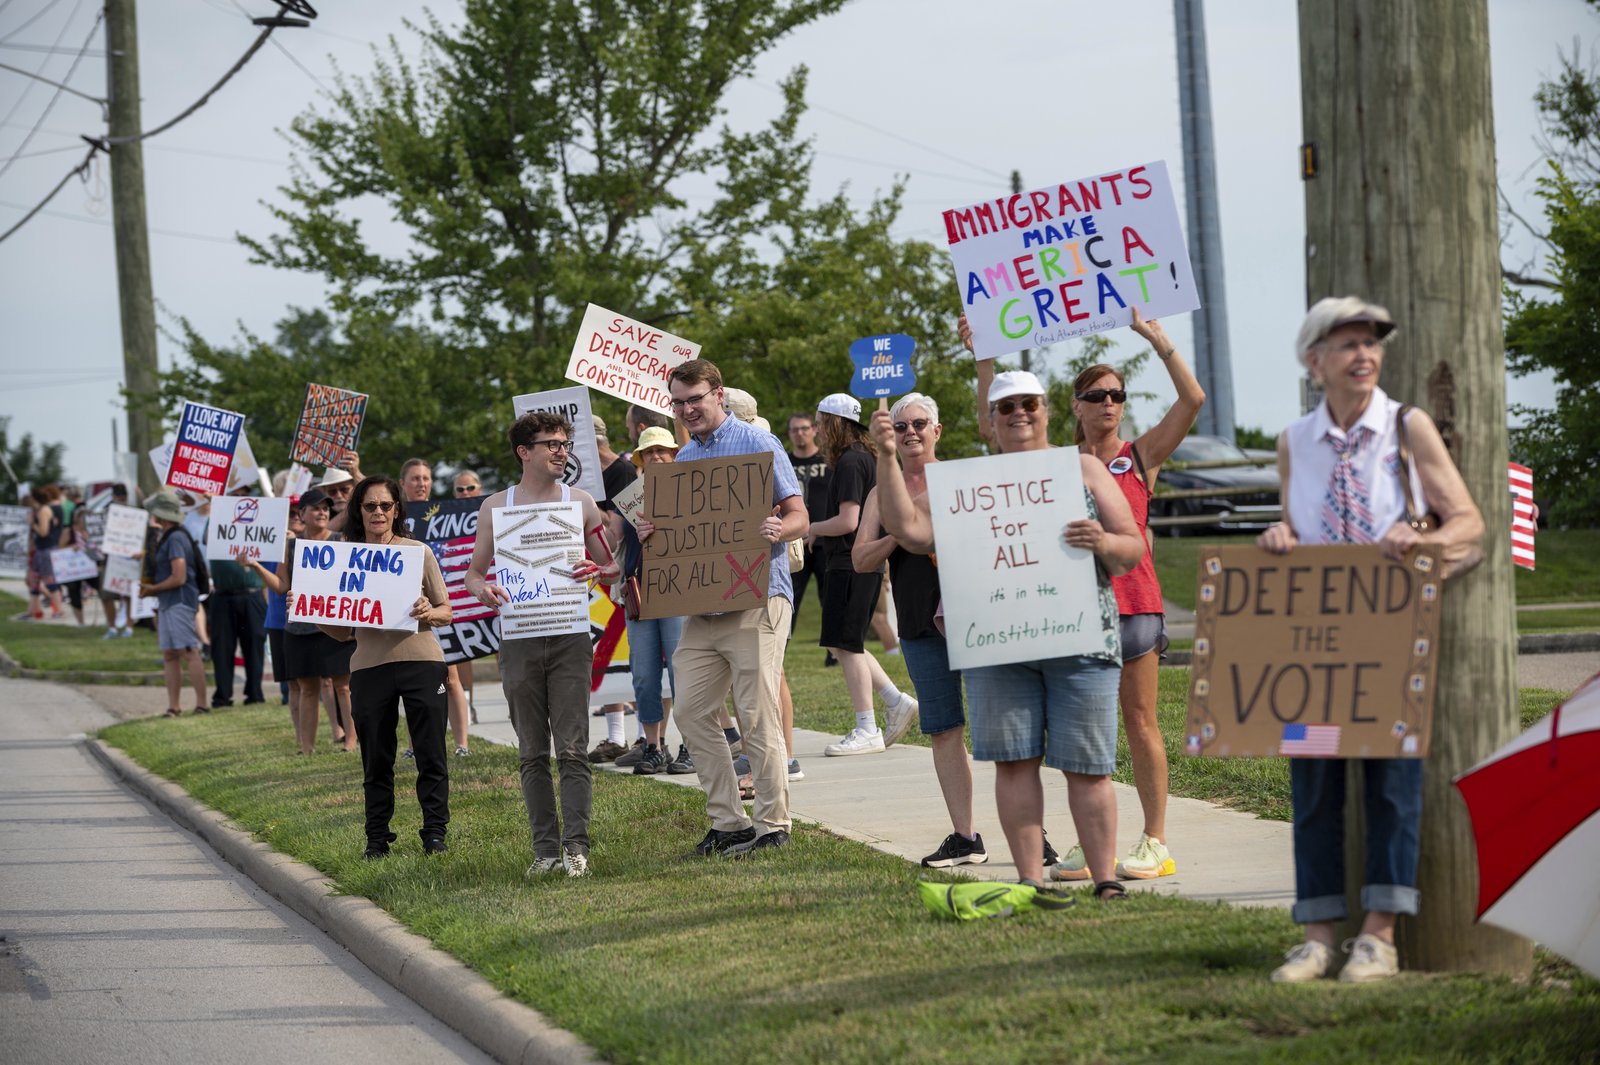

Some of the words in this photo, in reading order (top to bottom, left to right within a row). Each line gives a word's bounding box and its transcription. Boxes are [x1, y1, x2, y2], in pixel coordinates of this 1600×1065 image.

[942, 166, 1152, 245] IMMIGRANTS
[1023, 215, 1099, 248] MAKE
[967, 226, 1154, 305] AMERICA
[608, 319, 663, 350] SAVE
[672, 345, 692, 359] OUR
[874, 338, 891, 351] WE
[589, 332, 676, 381] DEMOCRAC
[872, 352, 893, 365] the
[606, 363, 622, 373] AND
[627, 369, 641, 380] THE
[862, 364, 904, 380] PEOPLE
[187, 405, 194, 422] I
[194, 407, 220, 428] LOVE
[220, 413, 238, 432] MY
[314, 396, 365, 416] WITHOUT
[185, 424, 232, 449] COUNTRY
[316, 414, 361, 436] PROCESS
[178, 445, 191, 460] I'M
[191, 449, 228, 468] ASHAMED
[171, 471, 223, 495] GOVERNMENT
[188, 462, 198, 474] OF
[198, 464, 213, 478] MY
[652, 462, 772, 519] LIBERTY
[950, 479, 1055, 514] JUSTICE
[217, 524, 237, 540] NO
[244, 525, 277, 544] KING
[656, 520, 745, 557] JUSTICE
[990, 516, 1028, 538] for
[229, 544, 239, 556] IN
[242, 545, 261, 558] USA
[302, 545, 335, 570] NO
[348, 547, 403, 576] KING
[994, 543, 1039, 570] ALL
[339, 571, 366, 592] IN
[497, 567, 525, 586] This
[647, 563, 681, 604] FOR
[688, 561, 722, 590] ALL
[506, 578, 550, 603] Week!
[1016, 587, 1027, 599] in
[1037, 583, 1059, 596] the
[1217, 564, 1413, 616] DEFEND
[295, 593, 383, 625] AMERICA
[965, 611, 1084, 648] Constitution!
[1289, 625, 1341, 652] THE
[1229, 662, 1382, 724] VOTE
